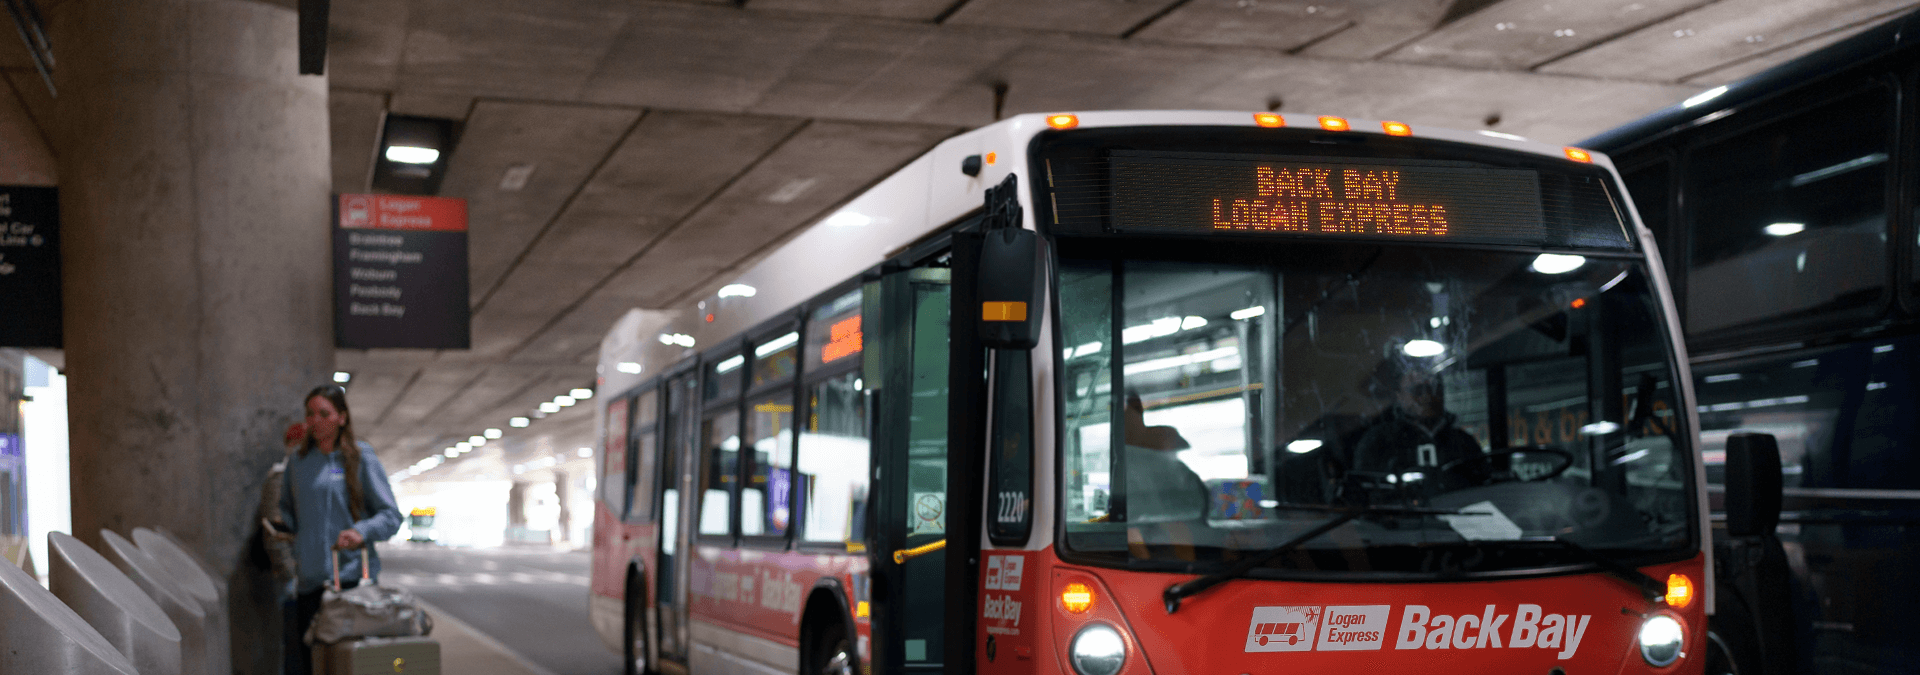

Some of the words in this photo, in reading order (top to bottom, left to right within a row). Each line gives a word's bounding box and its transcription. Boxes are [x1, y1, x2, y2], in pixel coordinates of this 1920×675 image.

[1257, 166, 1333, 198] BACK
[1343, 169, 1399, 200] BAY
[1213, 198, 1309, 231] LOGAN
[1319, 201, 1448, 235] EXPRESS
[350, 249, 423, 264] Framingham
[350, 267, 397, 280] Woburn
[350, 302, 379, 315] Back
[381, 303, 406, 318] Bay
[997, 491, 1024, 523] 2220
[984, 593, 1004, 618] Back
[1004, 595, 1022, 627] Bay
[1328, 610, 1367, 628] Logan
[1327, 628, 1380, 645] Express
[1395, 604, 1510, 650] Back
[1509, 603, 1592, 660] Bay
